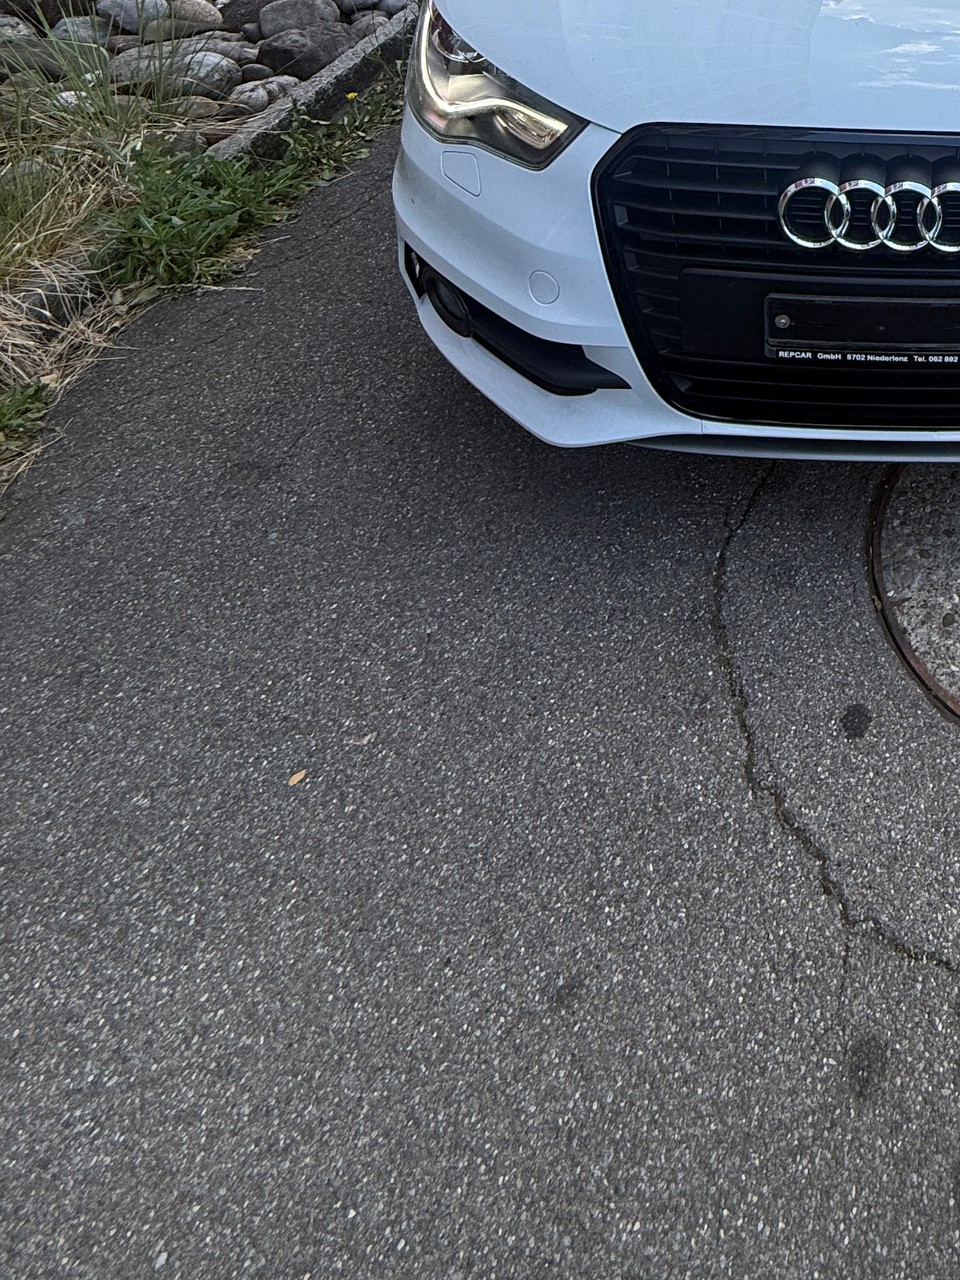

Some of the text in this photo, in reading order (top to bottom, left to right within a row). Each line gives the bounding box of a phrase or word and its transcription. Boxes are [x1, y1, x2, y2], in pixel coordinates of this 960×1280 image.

[778, 350, 812, 359] REPCAR
[817, 352, 842, 360] GmbH
[866, 354, 909, 362] Niederlenz
[913, 355, 927, 363] Tel.
[928, 355, 943, 363] 062
[944, 355, 959, 363] 892
